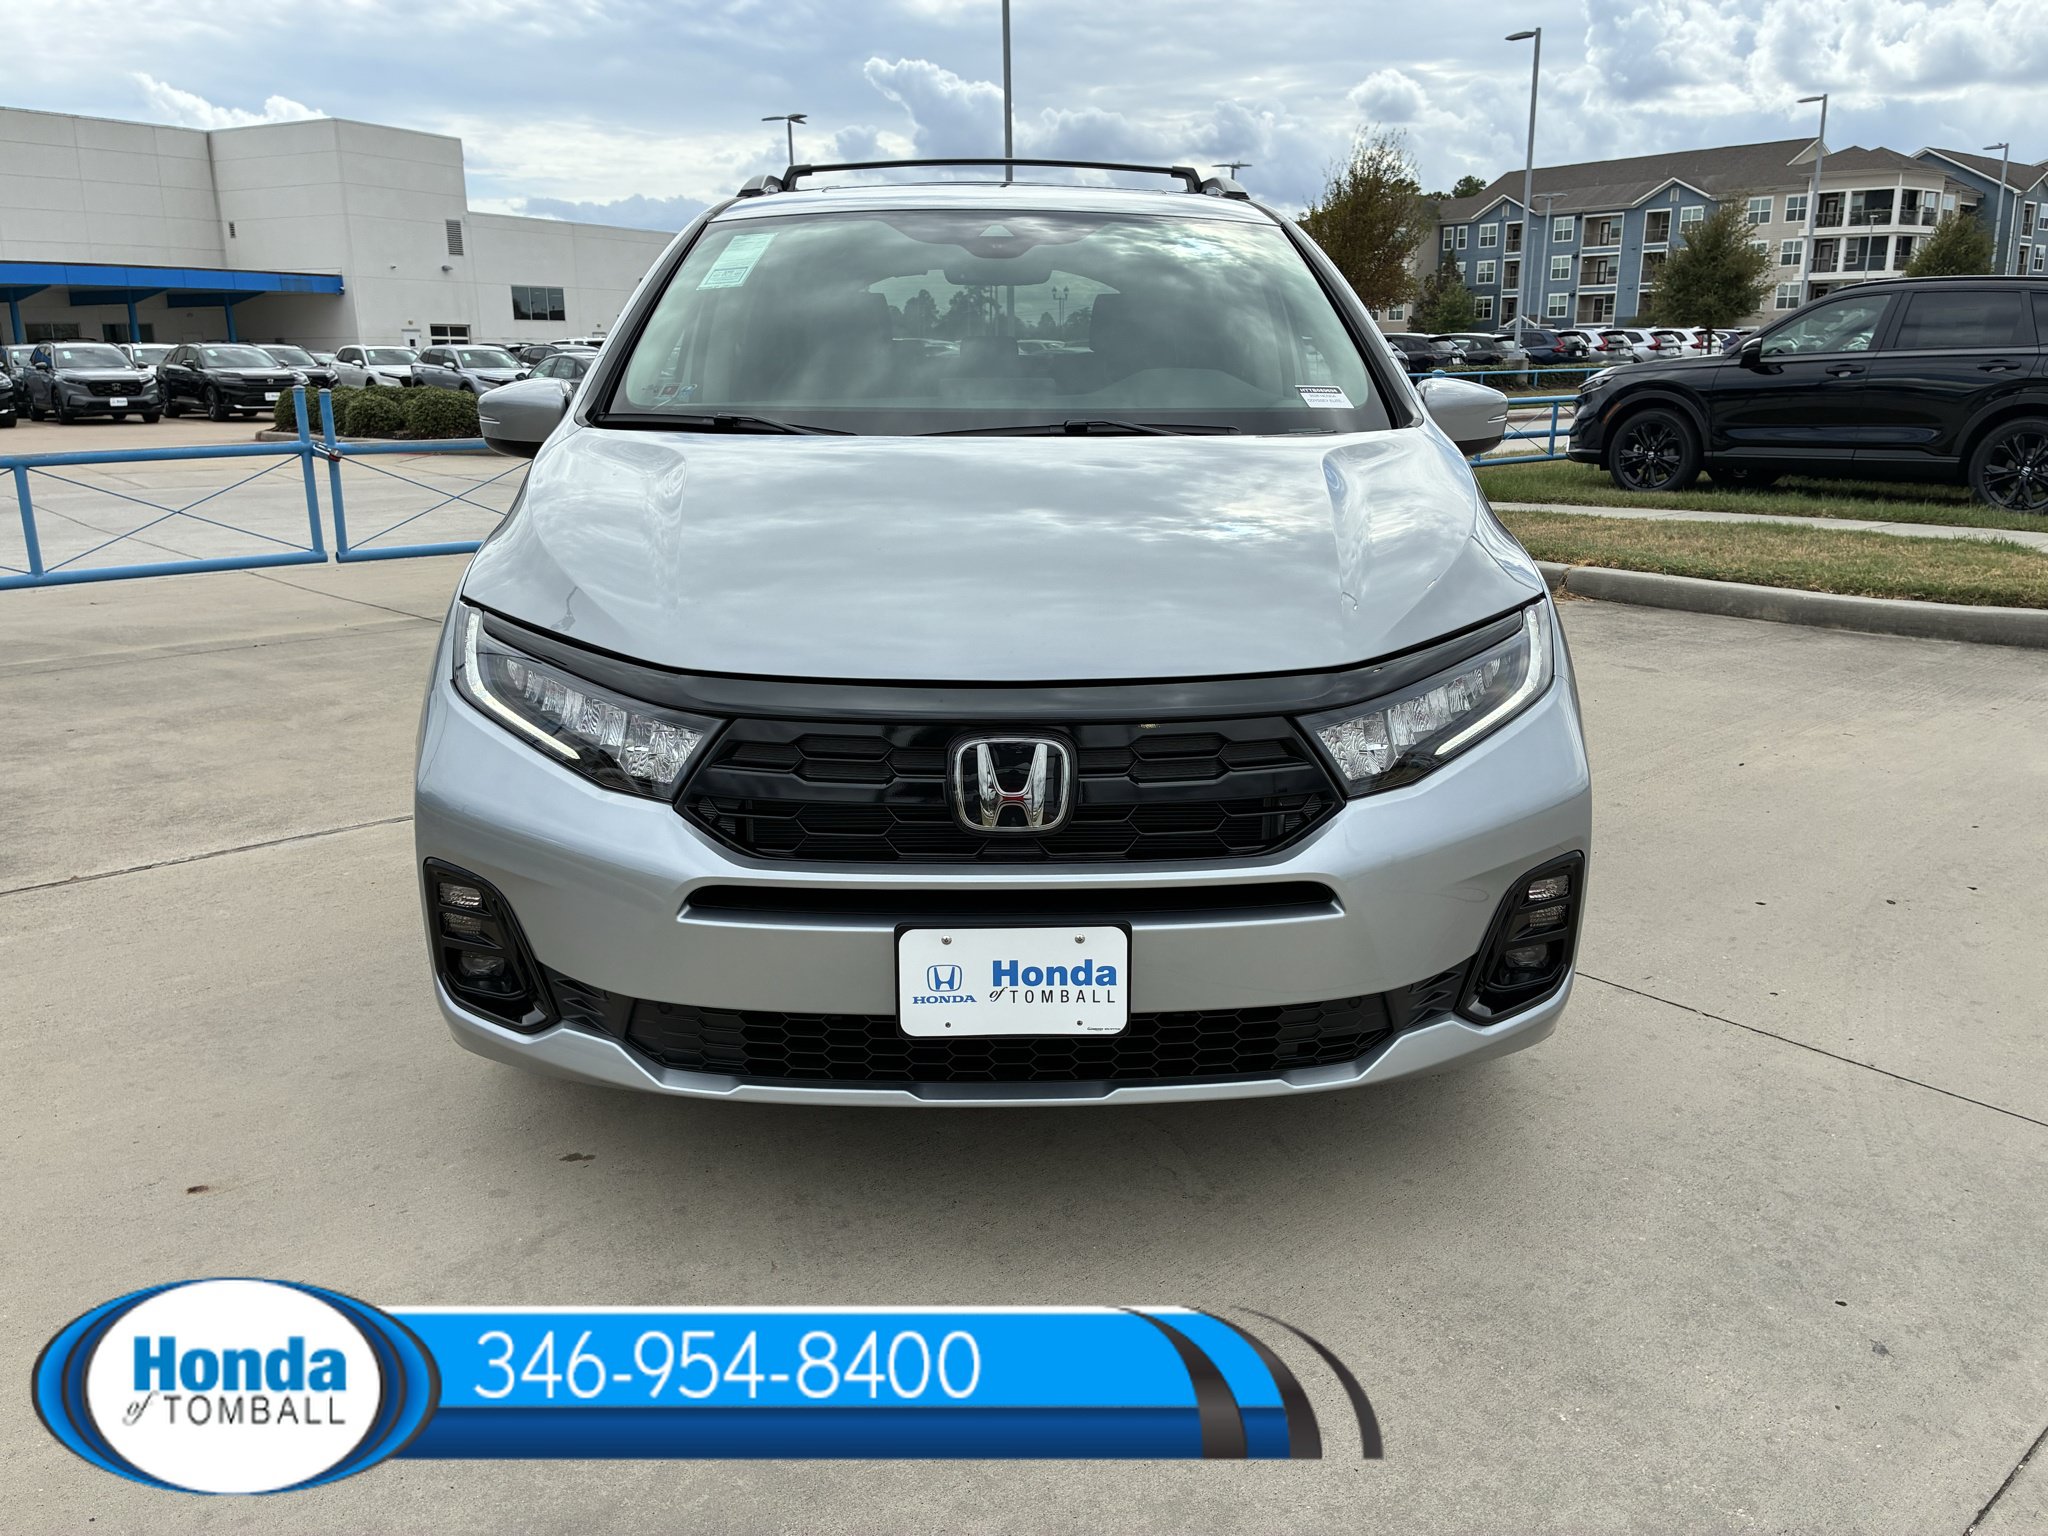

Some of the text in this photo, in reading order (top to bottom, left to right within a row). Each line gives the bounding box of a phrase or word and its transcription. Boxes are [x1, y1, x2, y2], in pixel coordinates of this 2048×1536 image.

[992, 959, 1117, 987] Honda
[912, 994, 978, 1005] HONDA
[989, 986, 1116, 1004] of TOMBALL
